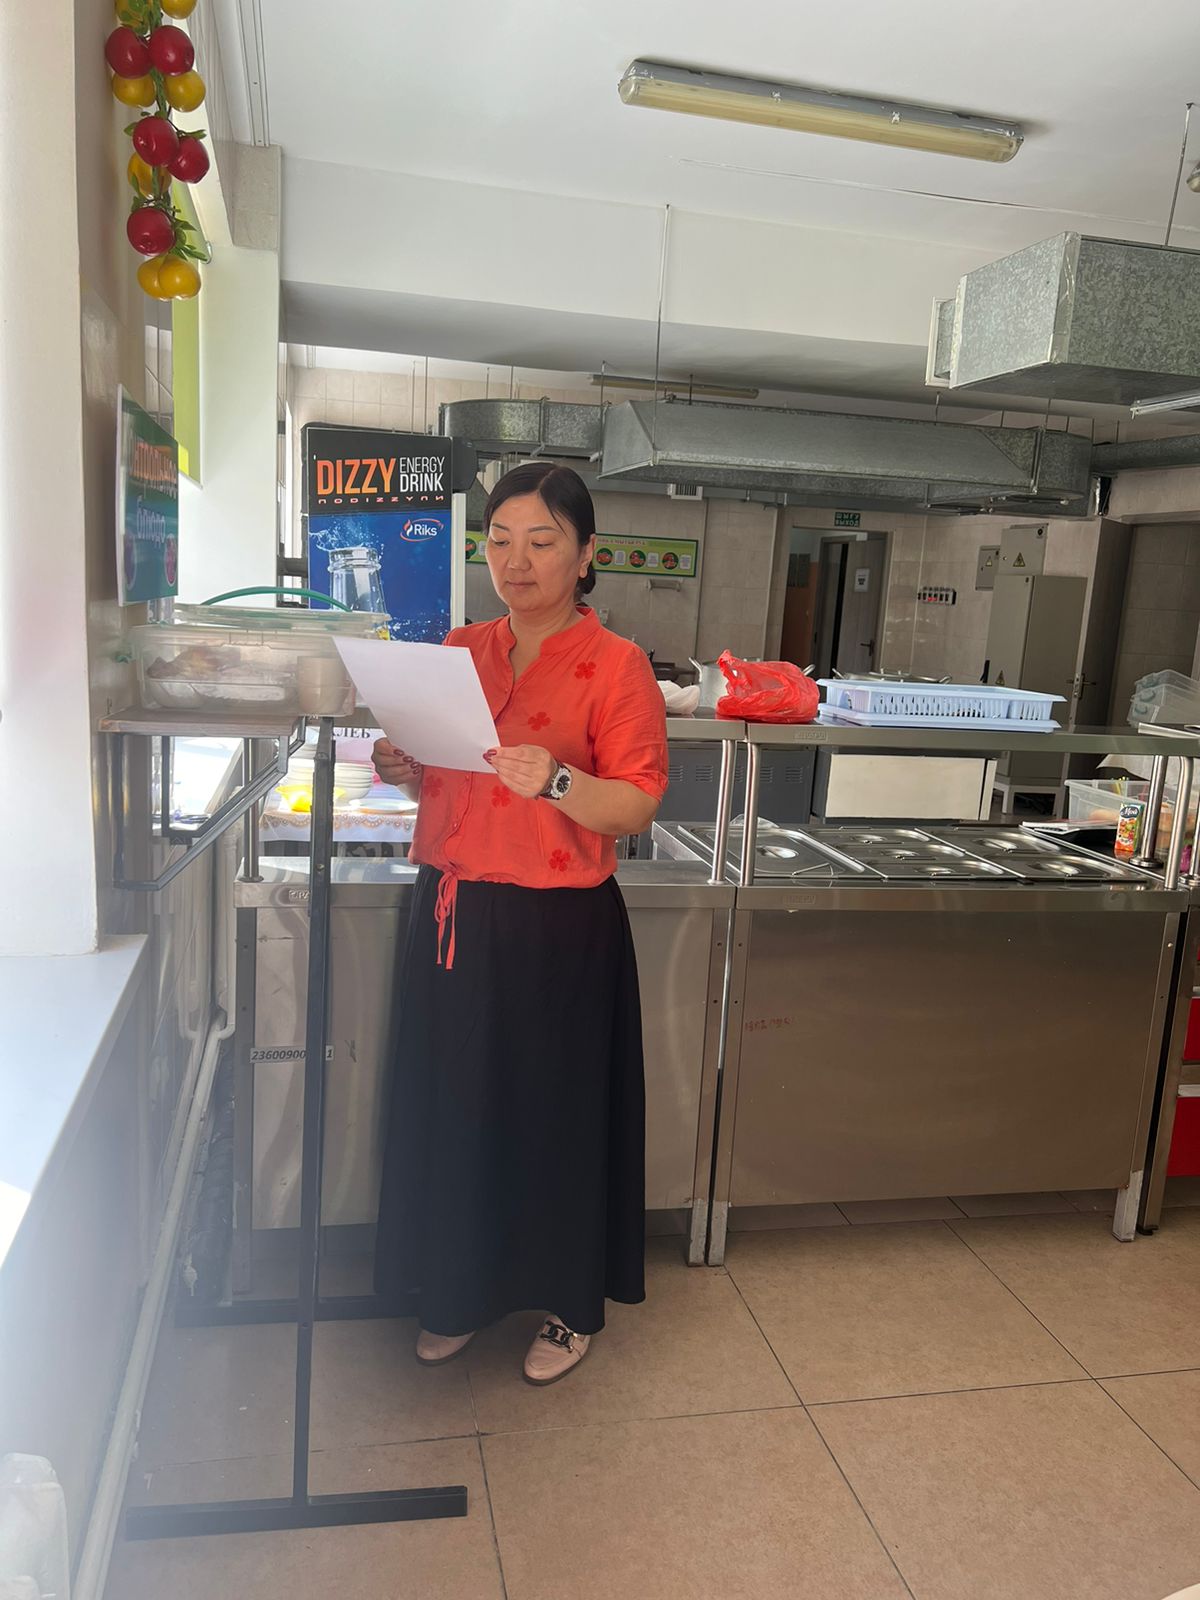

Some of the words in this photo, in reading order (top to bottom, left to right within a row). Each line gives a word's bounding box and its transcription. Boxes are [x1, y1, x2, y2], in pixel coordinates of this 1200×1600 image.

[399, 456, 445, 474] ENERGY
[316, 458, 397, 495] DIZZY
[399, 472, 444, 493] DRINK
[413, 523, 438, 537] Riks
[332, 727, 371, 739] ЛЕБ
